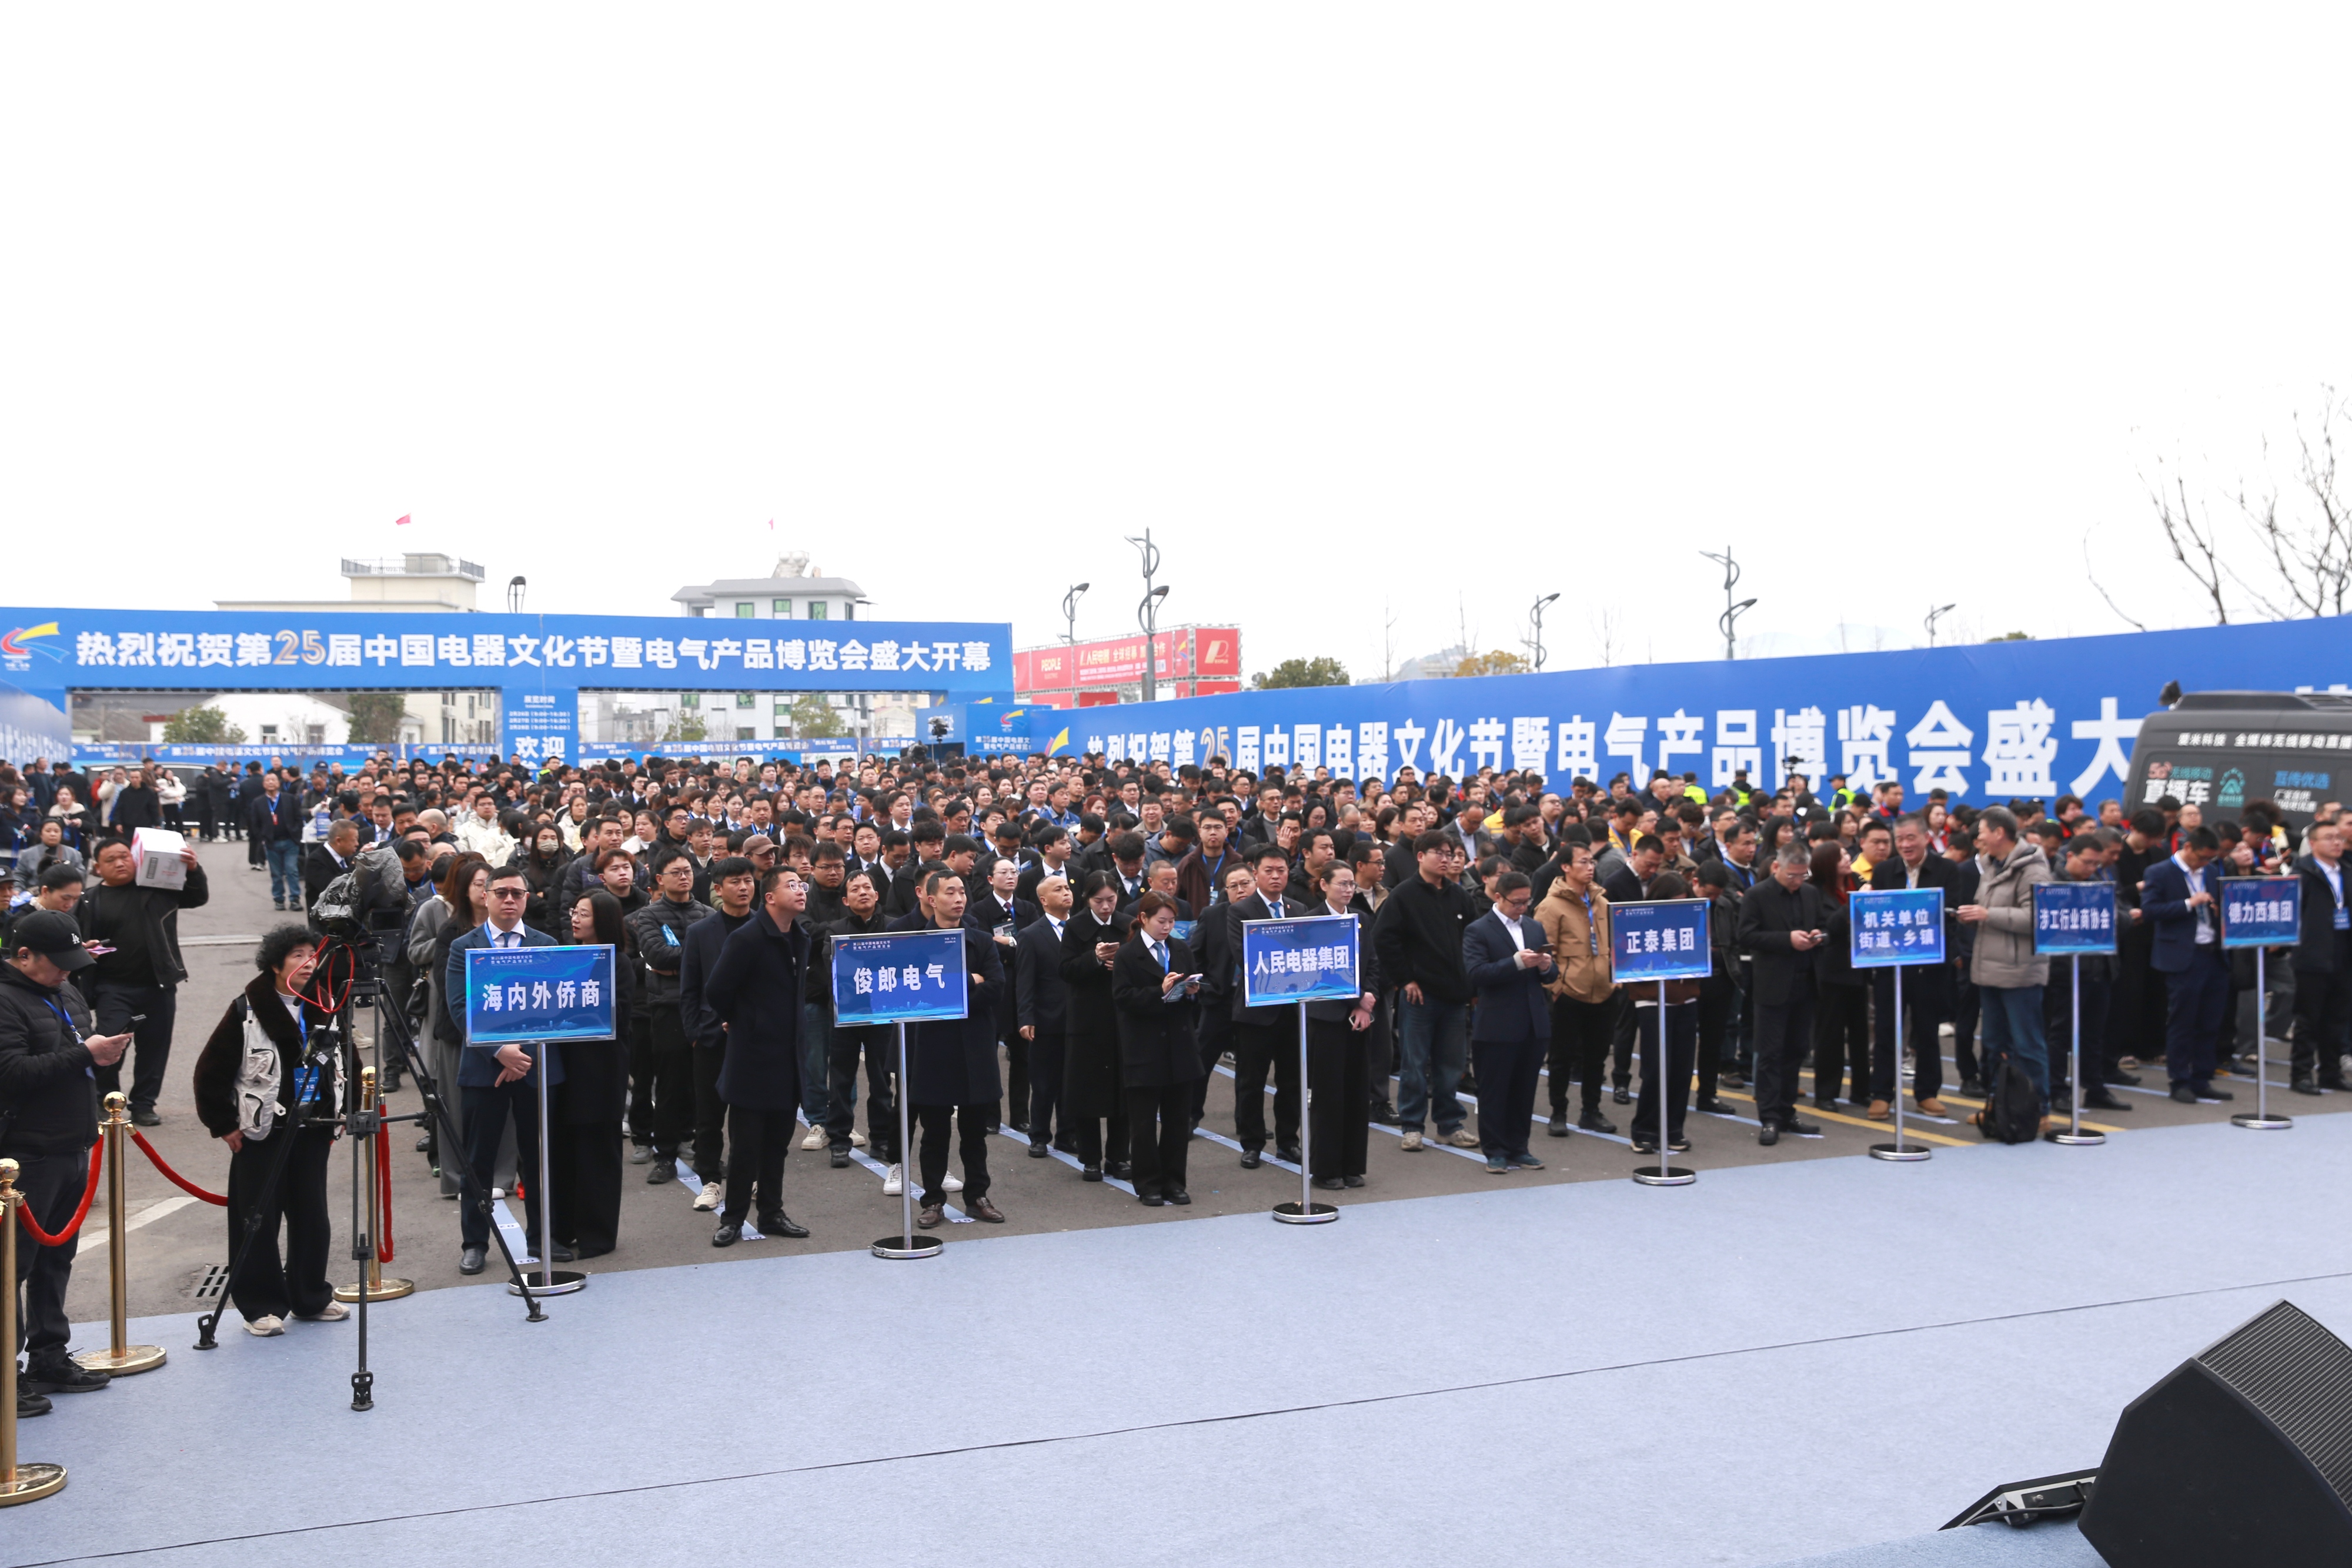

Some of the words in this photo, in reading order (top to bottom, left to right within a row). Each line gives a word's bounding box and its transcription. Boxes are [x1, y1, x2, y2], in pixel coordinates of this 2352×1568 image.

[76, 630, 992, 671] 热烈祝贺第25届中国电器文化节暨电气产品博览会盛大开幕
[1140, 641, 1165, 658] 加合作
[1041, 658, 1061, 671] PEOPLE
[515, 735, 566, 759] 欢迎
[2143, 778, 2211, 806] 直播车
[1863, 908, 1929, 929] 机关单位
[2039, 907, 2110, 930] 涉工行业商协会
[2229, 900, 2293, 924] 德力西集团
[1626, 928, 1695, 954] 正泰集团
[1859, 928, 1935, 949] 街道、乡镇
[1253, 945, 1349, 975] 人民电器集团
[853, 963, 946, 995] 俊郎电气
[482, 979, 600, 1011] 海内外侨商
